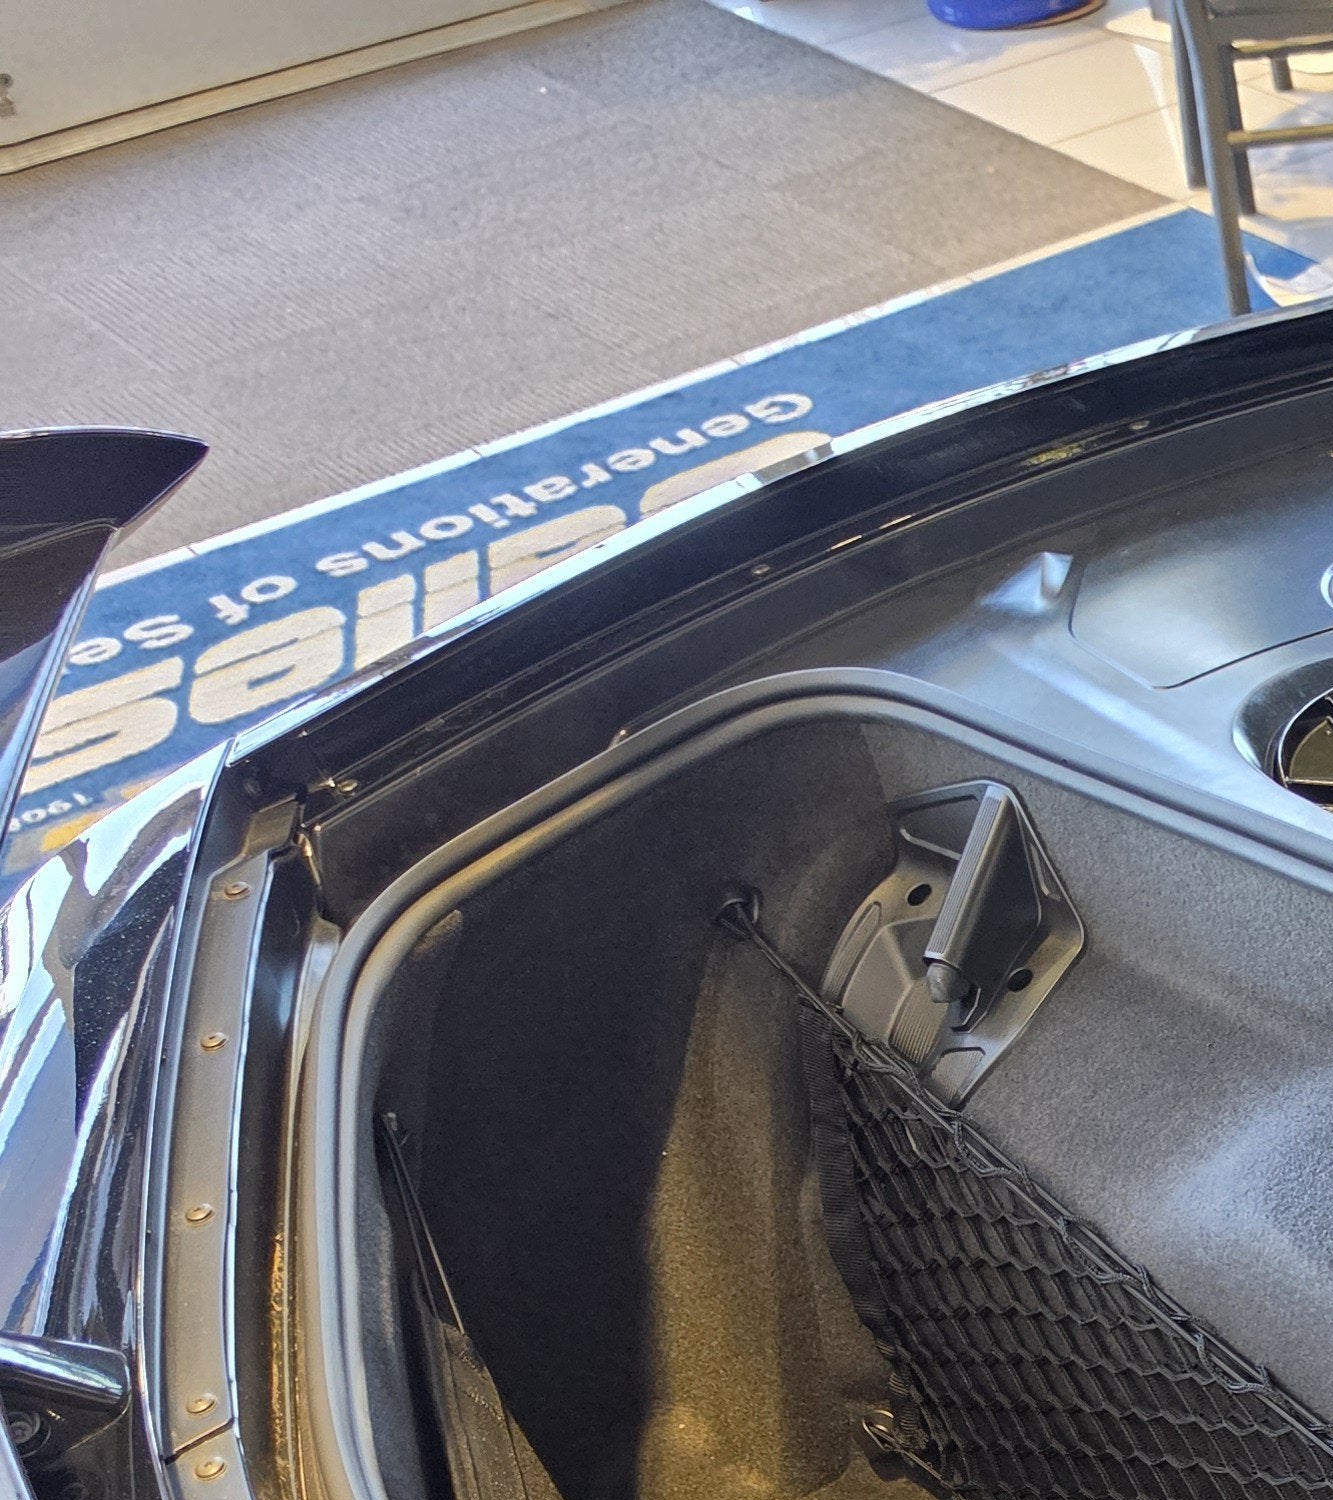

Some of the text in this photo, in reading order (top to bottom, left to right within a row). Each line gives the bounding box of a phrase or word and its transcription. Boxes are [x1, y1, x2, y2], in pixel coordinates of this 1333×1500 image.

[60, 392, 814, 677] Generations of Se
